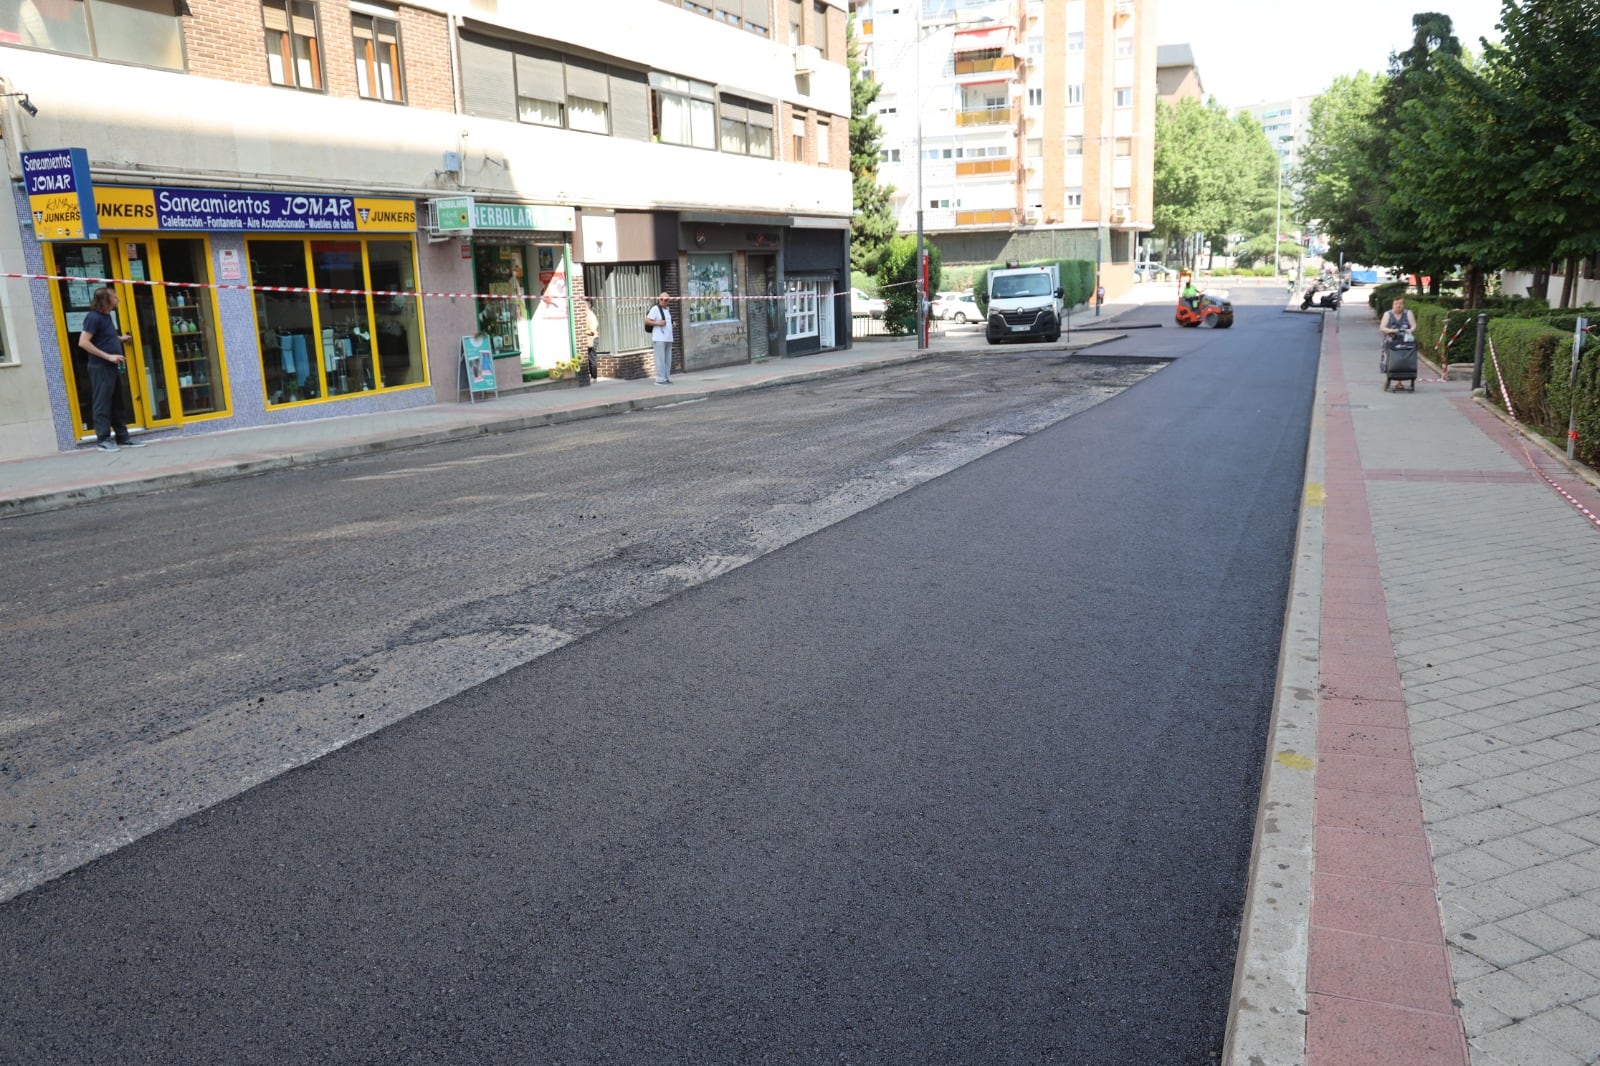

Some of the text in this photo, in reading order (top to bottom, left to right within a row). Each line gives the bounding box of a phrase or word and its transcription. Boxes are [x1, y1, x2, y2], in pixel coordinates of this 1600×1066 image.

[24, 153, 72, 171] Saneamientos
[32, 174, 71, 191] JOMAR
[159, 191, 352, 216] Saneamientos JOMAR
[44, 211, 80, 222] JUNKERS
[247, 216, 260, 228] Aire
[261, 217, 305, 229] Acondicionado
[371, 211, 416, 223] JUNKERS
